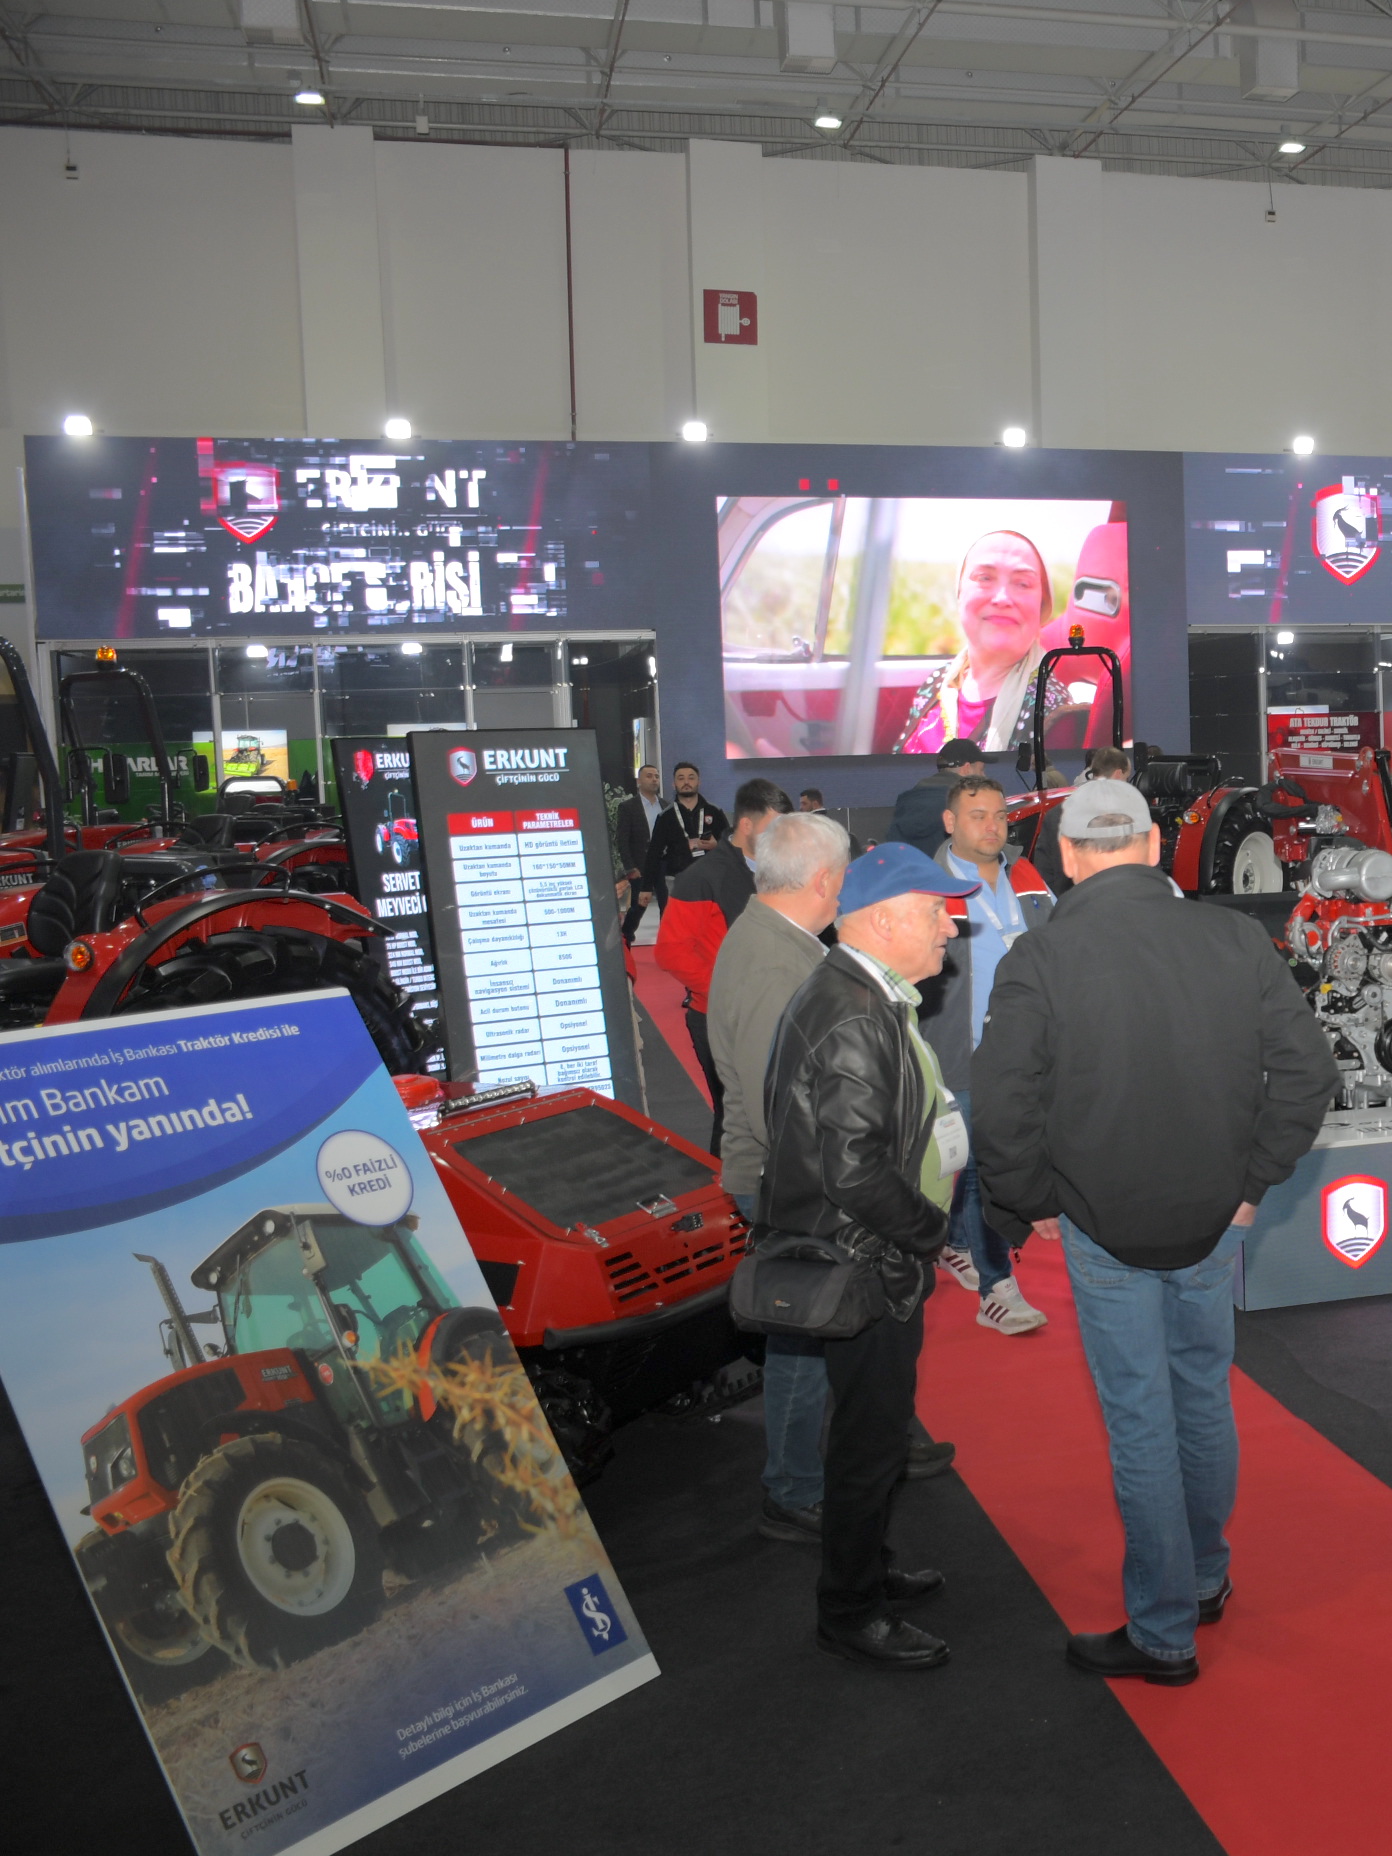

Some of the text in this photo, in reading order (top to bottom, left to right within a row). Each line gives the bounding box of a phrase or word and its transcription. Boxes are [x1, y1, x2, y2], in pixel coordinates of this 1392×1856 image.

[376, 752, 410, 768] ERKU
[482, 747, 567, 770] ERKUNT
[496, 772, 560, 785] ÇİFTÇİNİN GÜCÜ
[471, 816, 494, 829] ÜRÜN
[523, 819, 575, 830] PARAMETRELER
[535, 811, 560, 820] TEKNİK
[485, 842, 511, 850] kumanda
[0, 873, 33, 887] KUNT
[382, 871, 421, 893] SERVET
[376, 891, 423, 918] MEYVECİ
[30, 1052, 110, 1077] alımlarında
[108, 1048, 124, 1066] İş
[123, 1044, 178, 1062] Bankası
[177, 1034, 231, 1052] Traktör
[231, 1026, 282, 1044] Kredisi
[281, 1024, 300, 1036] ile
[40, 1075, 170, 1117] Bankam
[0, 1092, 253, 1171] tçinin yanında!
[325, 1153, 398, 1183] %0 FAİZLİ
[346, 1173, 393, 1197] KREDİ
[396, 1673, 519, 1742] Detaylı bilgi için İş Bankası
[398, 1685, 529, 1761] şubelerine başvurabilirsiniz.
[219, 1769, 309, 1832] ERKUNT
